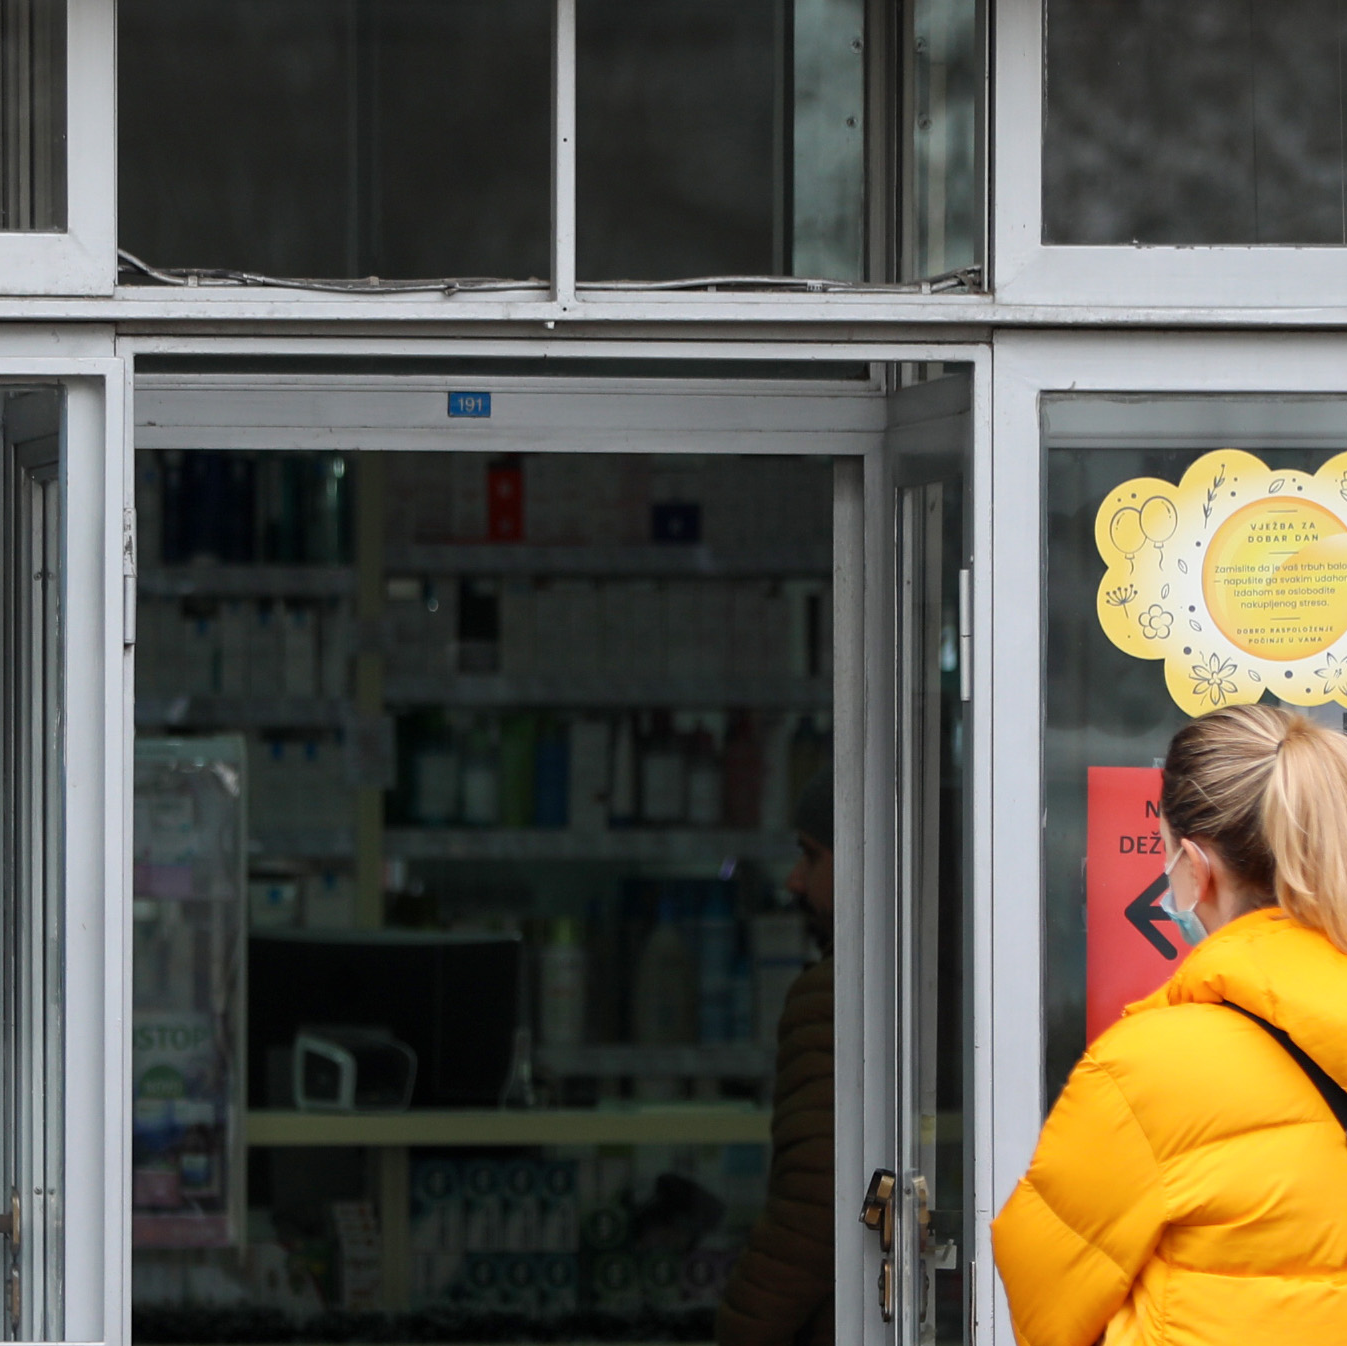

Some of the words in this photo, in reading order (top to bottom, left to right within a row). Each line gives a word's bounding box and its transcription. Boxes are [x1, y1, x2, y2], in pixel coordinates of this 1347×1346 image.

[459, 397, 483, 412] 191
[1251, 522, 1294, 530] VJEŽBA
[1248, 535, 1287, 543] DOBAR
[1215, 565, 1254, 573] Zamislite
[1258, 564, 1270, 572] da
[1272, 564, 1280, 574] je
[1224, 577, 1263, 586] napušite
[1266, 578, 1277, 586] ga
[1280, 575, 1312, 583] svakim
[1234, 589, 1273, 597] Izdahom
[1288, 587, 1335, 595] oslobodite
[1241, 600, 1296, 610] nakupljenog
